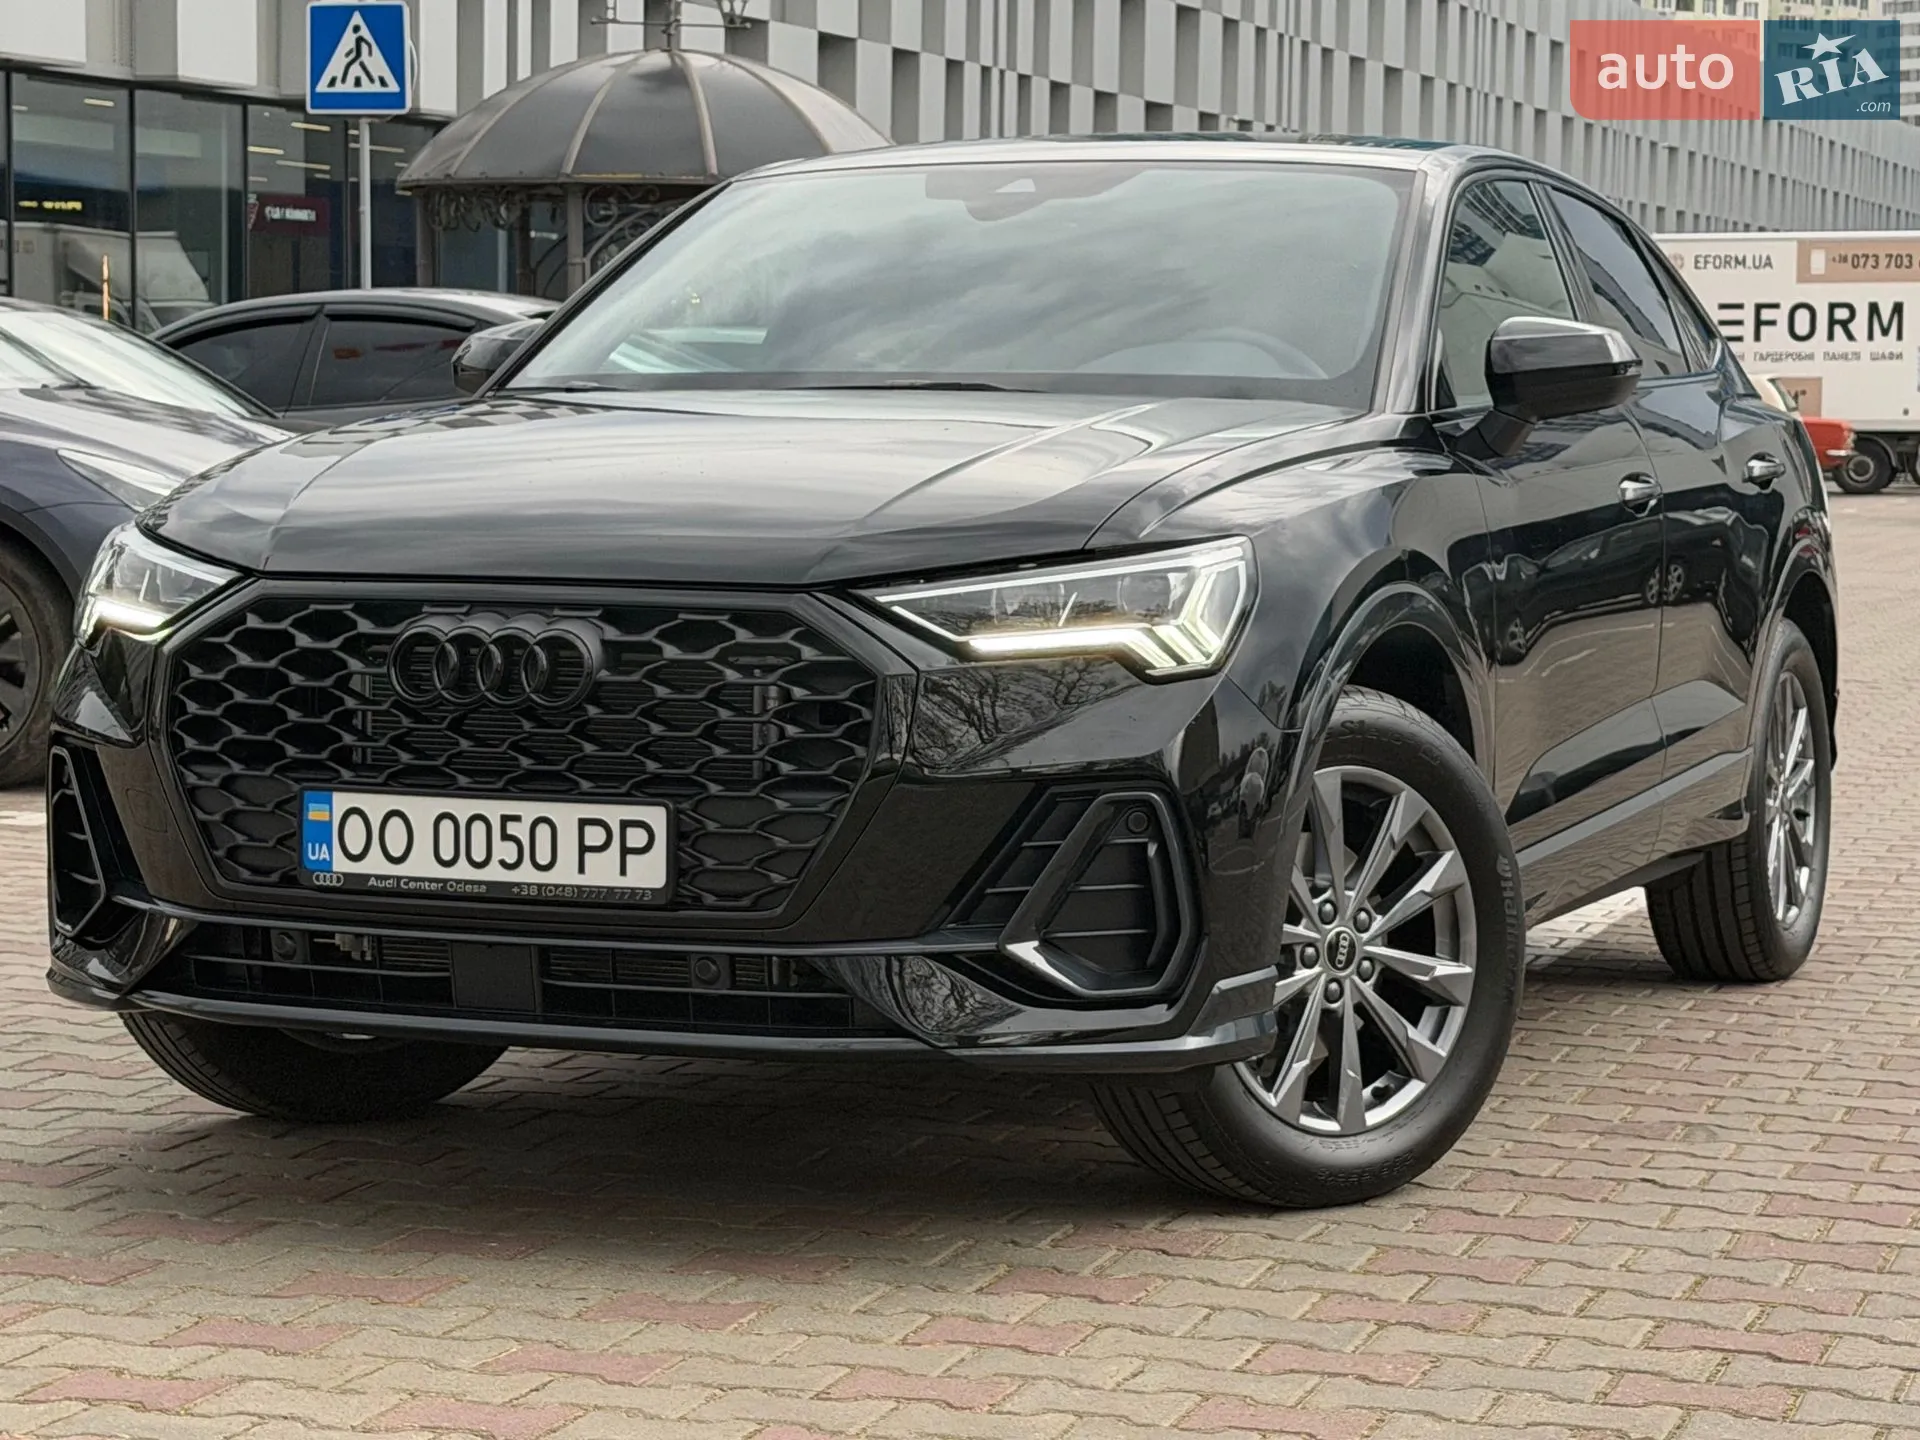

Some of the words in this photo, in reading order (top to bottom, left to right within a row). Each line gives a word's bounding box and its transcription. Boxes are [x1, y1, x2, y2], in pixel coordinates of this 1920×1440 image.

[1693, 254, 1773, 270] EFORM.UA
[1851, 253, 1880, 269] 073
[1884, 253, 1914, 269] 703
[1717, 301, 1904, 342] EFORM
[1869, 350, 1904, 361] ШАФИ
[337, 806, 414, 866] OO
[432, 811, 559, 872] 0050
[577, 817, 656, 877] PP
[308, 842, 331, 861] UA
[367, 876, 397, 889] Audi
[400, 878, 444, 891] Center
[511, 884, 539, 896] +38
[541, 885, 578, 898] (048)
[581, 888, 608, 899] 777
